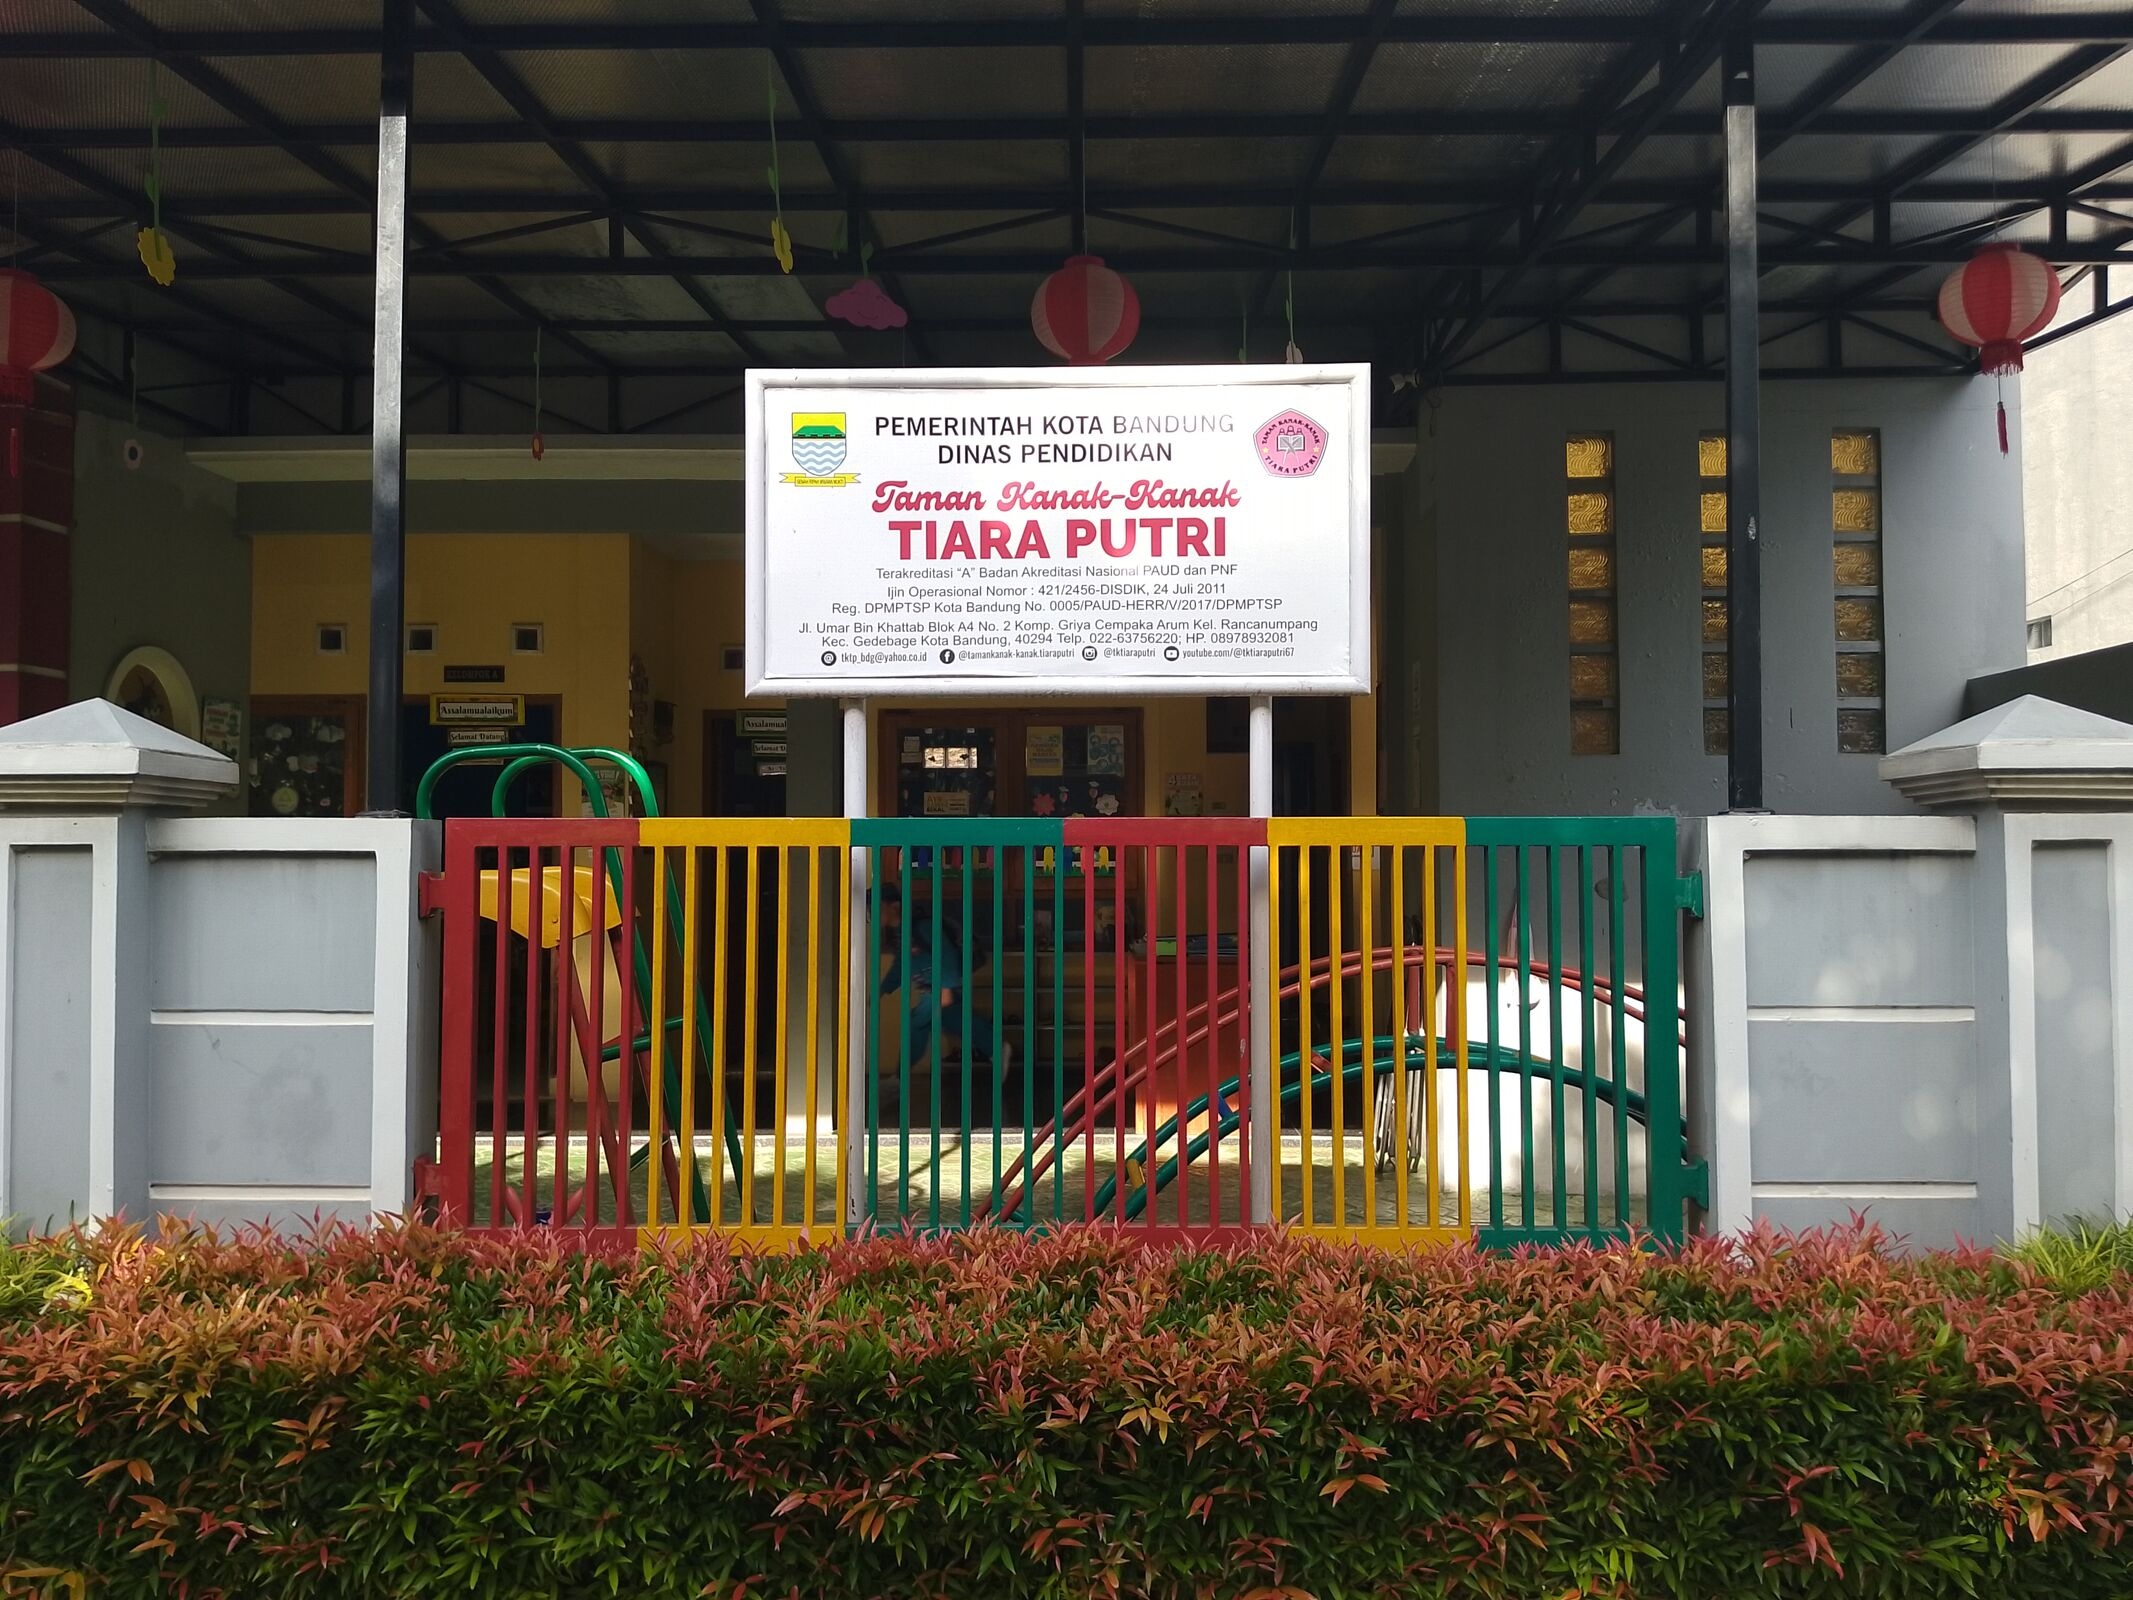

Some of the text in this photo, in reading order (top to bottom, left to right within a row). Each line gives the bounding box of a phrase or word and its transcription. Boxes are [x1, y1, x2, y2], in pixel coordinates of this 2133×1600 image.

[875, 414, 1234, 437] PEMERINTAH KOTA BANDUNG
[938, 443, 1172, 465] DINAS PENDIDIKAN
[871, 478, 1242, 513] Taman Kanak-Kanak
[888, 517, 1227, 561] TIARA PUTRI
[876, 567, 954, 579] Terakreditasi
[979, 567, 1018, 578] Badan
[1022, 566, 1082, 578] Akreditasi
[1085, 565, 1138, 577] Nasional
[1143, 565, 1180, 576] PAUD
[1184, 564, 1207, 576] dan
[1211, 564, 1238, 575] PNF
[887, 586, 905, 600] Ijin
[909, 586, 983, 599] Operasional
[986, 586, 1027, 597] Nomor
[1038, 584, 1150, 597] 421/2456-DISDIK,
[1153, 584, 1169, 595] 24
[1173, 583, 1194, 595] Juli
[1197, 583, 1227, 594] 2011
[832, 599, 1283, 617] Reg. DPMPTSP Kota Bandung No. 0005/PAUD-HERR/V/2017/DPMPTSP
[798, 618, 1318, 634] Jl. Umar Bin Khattab Blok A4 No. 2 Komp. Griya Cempaka Arum Kel. Rancanumpang
[821, 632, 1295, 649] Kec. Gedebage Kota Bandung, 40294 Telp. 022-63756220; HP. 08978932081
[1103, 648, 1156, 659] @tktiaraputri
[1183, 647, 1295, 659] youtube.com/@tktiaraputri67
[440, 705, 513, 717] Assalamualaikum
[745, 720, 787, 728] Assalamual
[450, 732, 477, 742] Selamat
